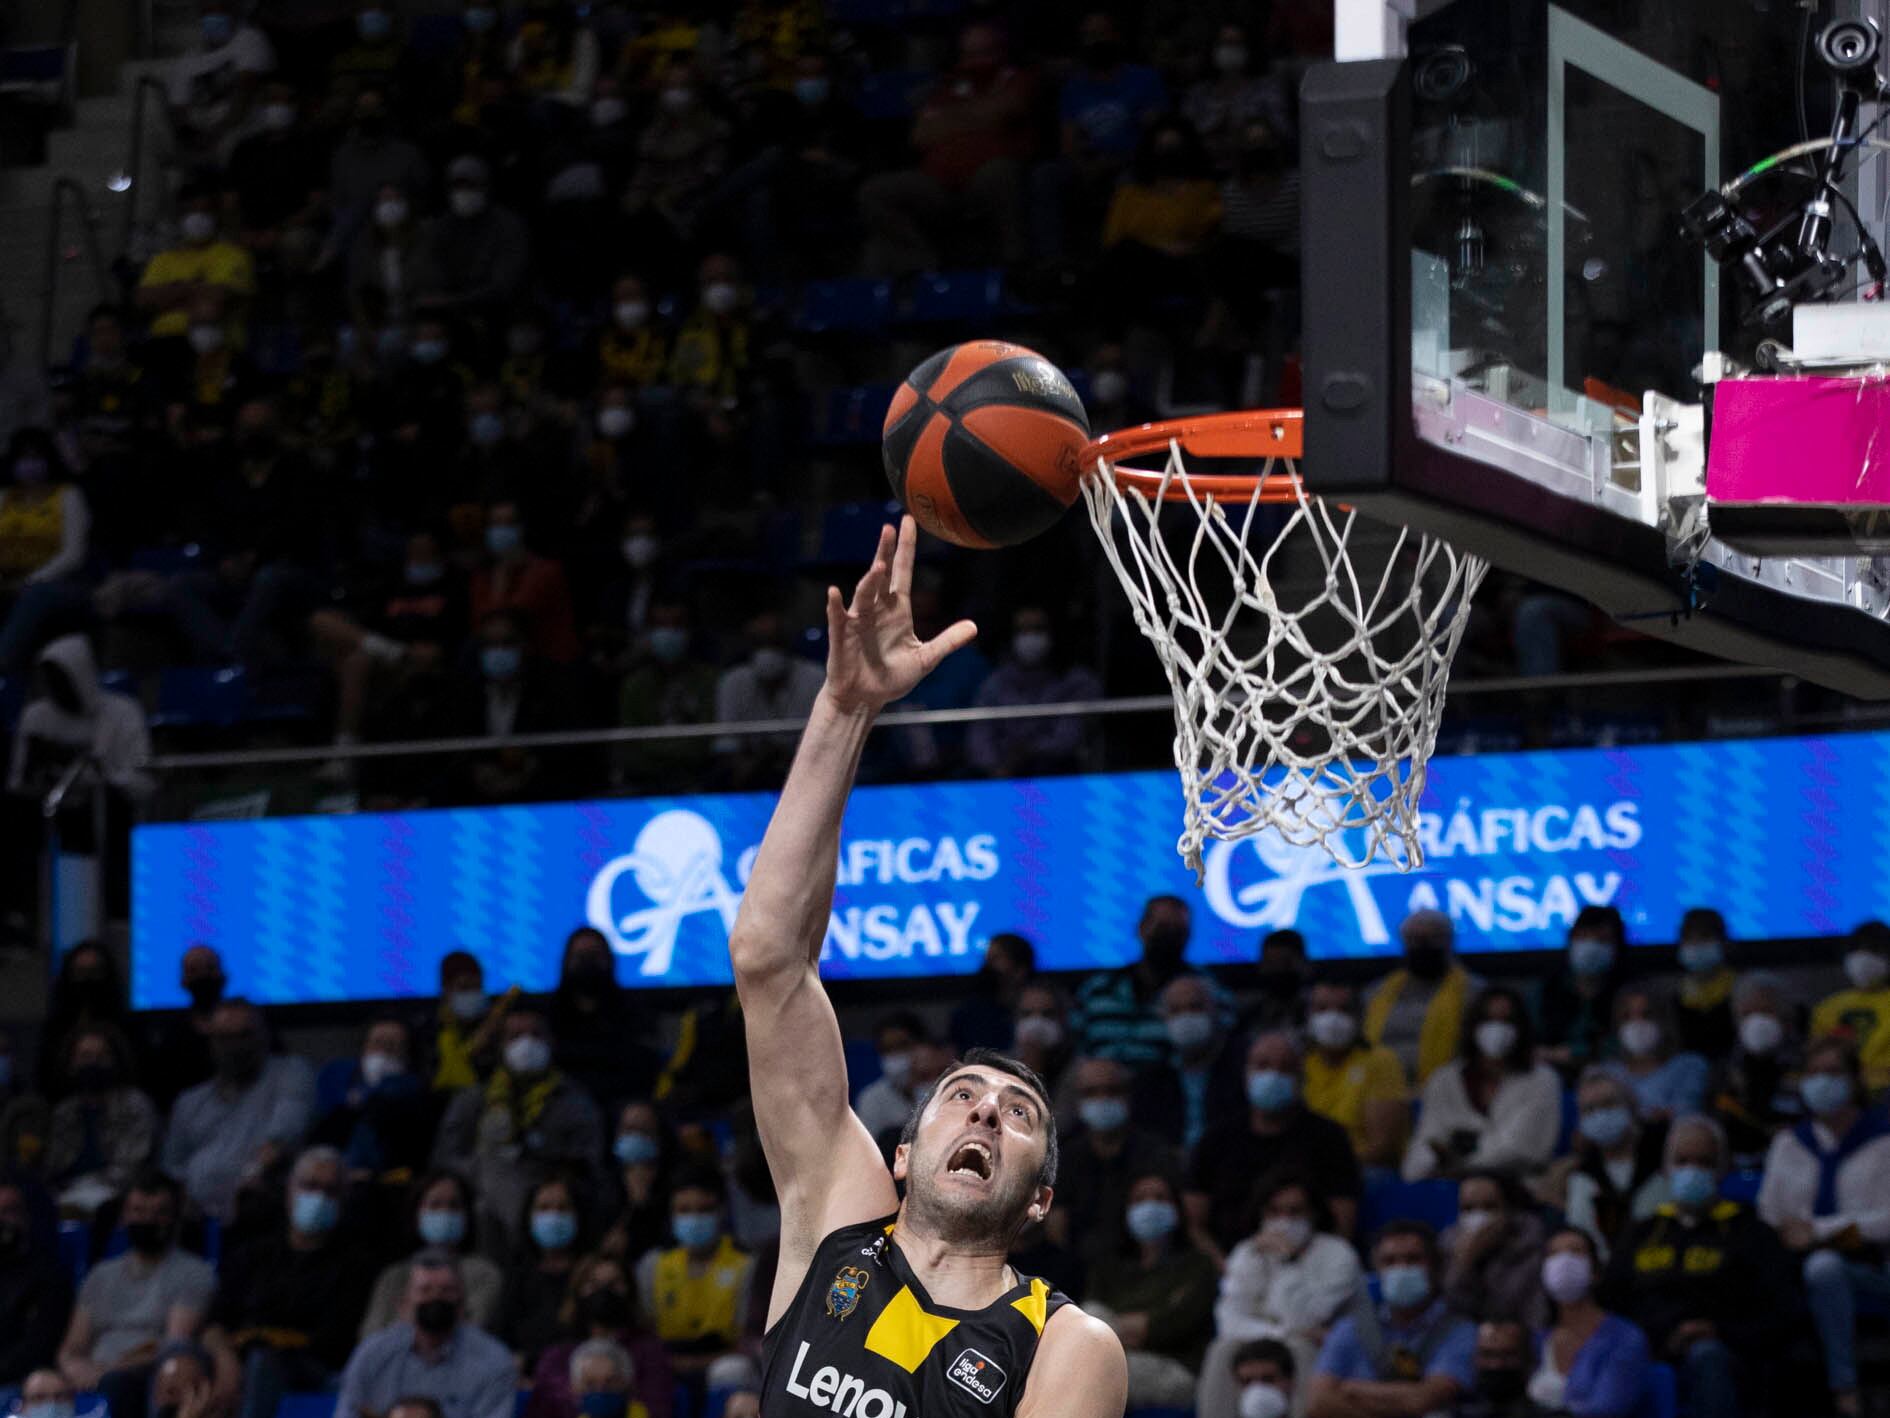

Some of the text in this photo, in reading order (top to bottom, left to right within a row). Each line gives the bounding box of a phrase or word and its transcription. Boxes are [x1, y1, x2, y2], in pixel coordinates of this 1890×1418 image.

[820, 901, 980, 961] NSAY
[959, 1358, 979, 1375] liga
[954, 1368, 992, 1398] endesa
